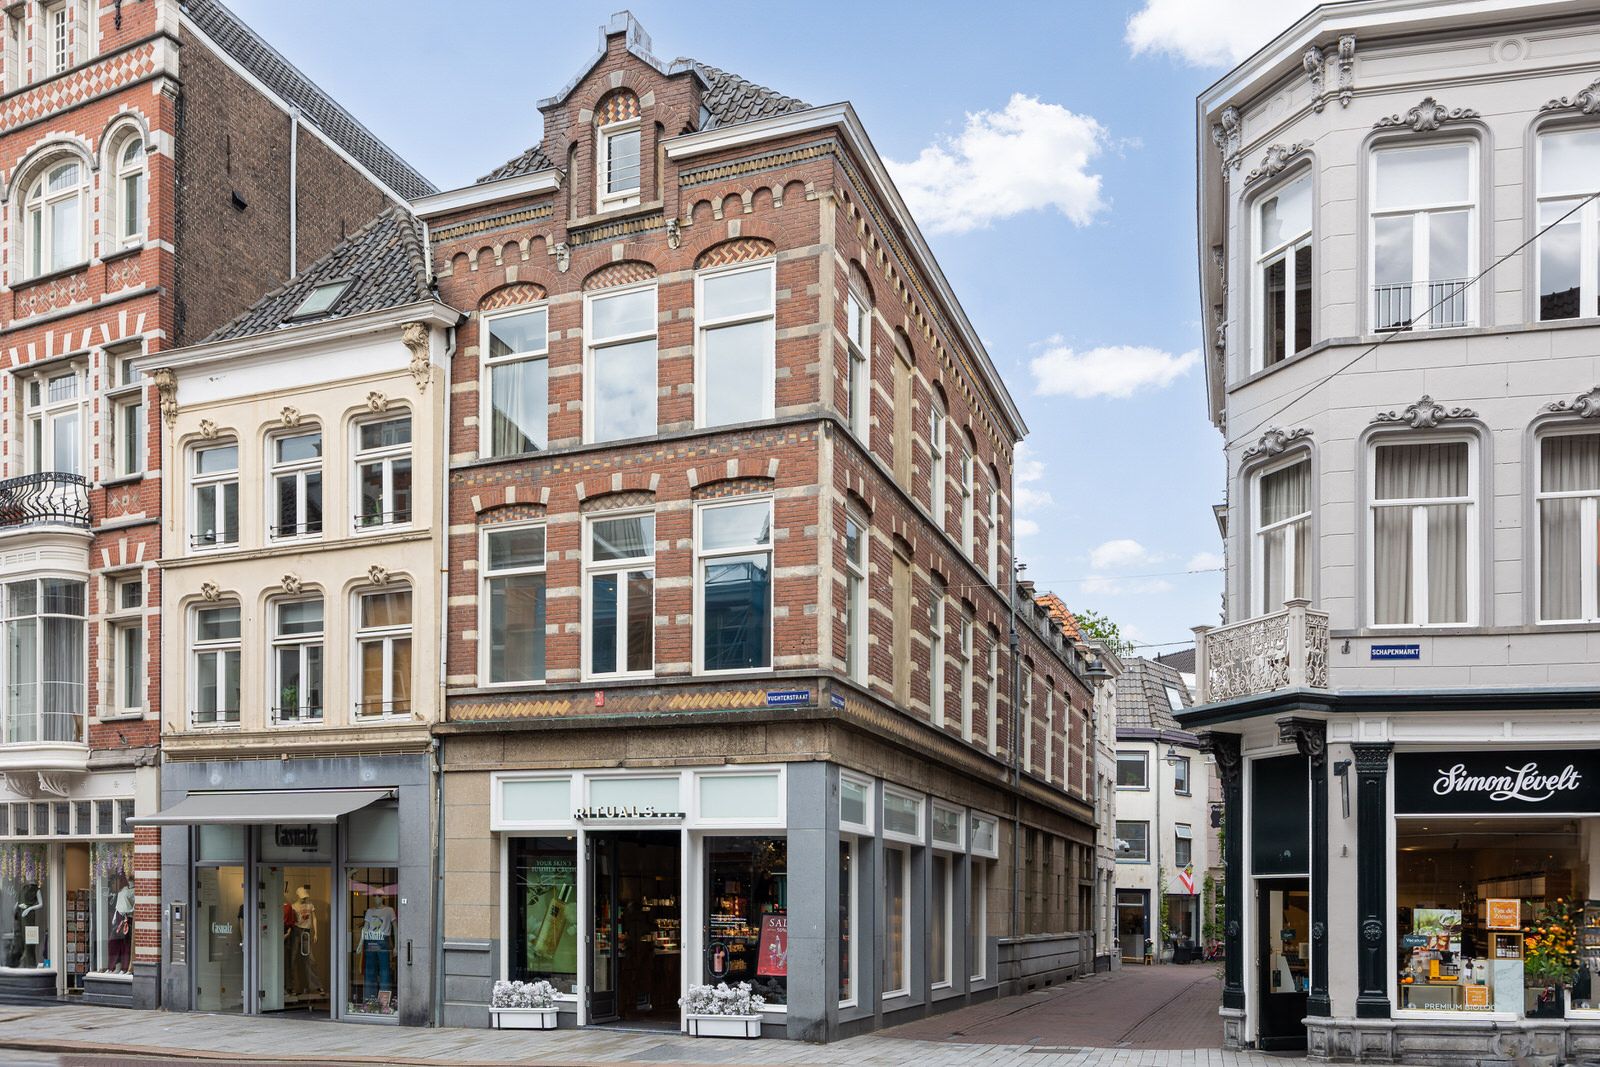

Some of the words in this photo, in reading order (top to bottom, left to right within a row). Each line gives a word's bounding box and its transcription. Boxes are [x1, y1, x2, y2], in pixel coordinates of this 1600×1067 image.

[1371, 648, 1419, 656] SCHAPENMARKT
[767, 694, 808, 702] VUGHTERSTRAAT
[1432, 763, 1514, 796] Simon
[1490, 762, 1582, 802] Lévelt
[1424, 1002, 1462, 1010] PREMIUM
